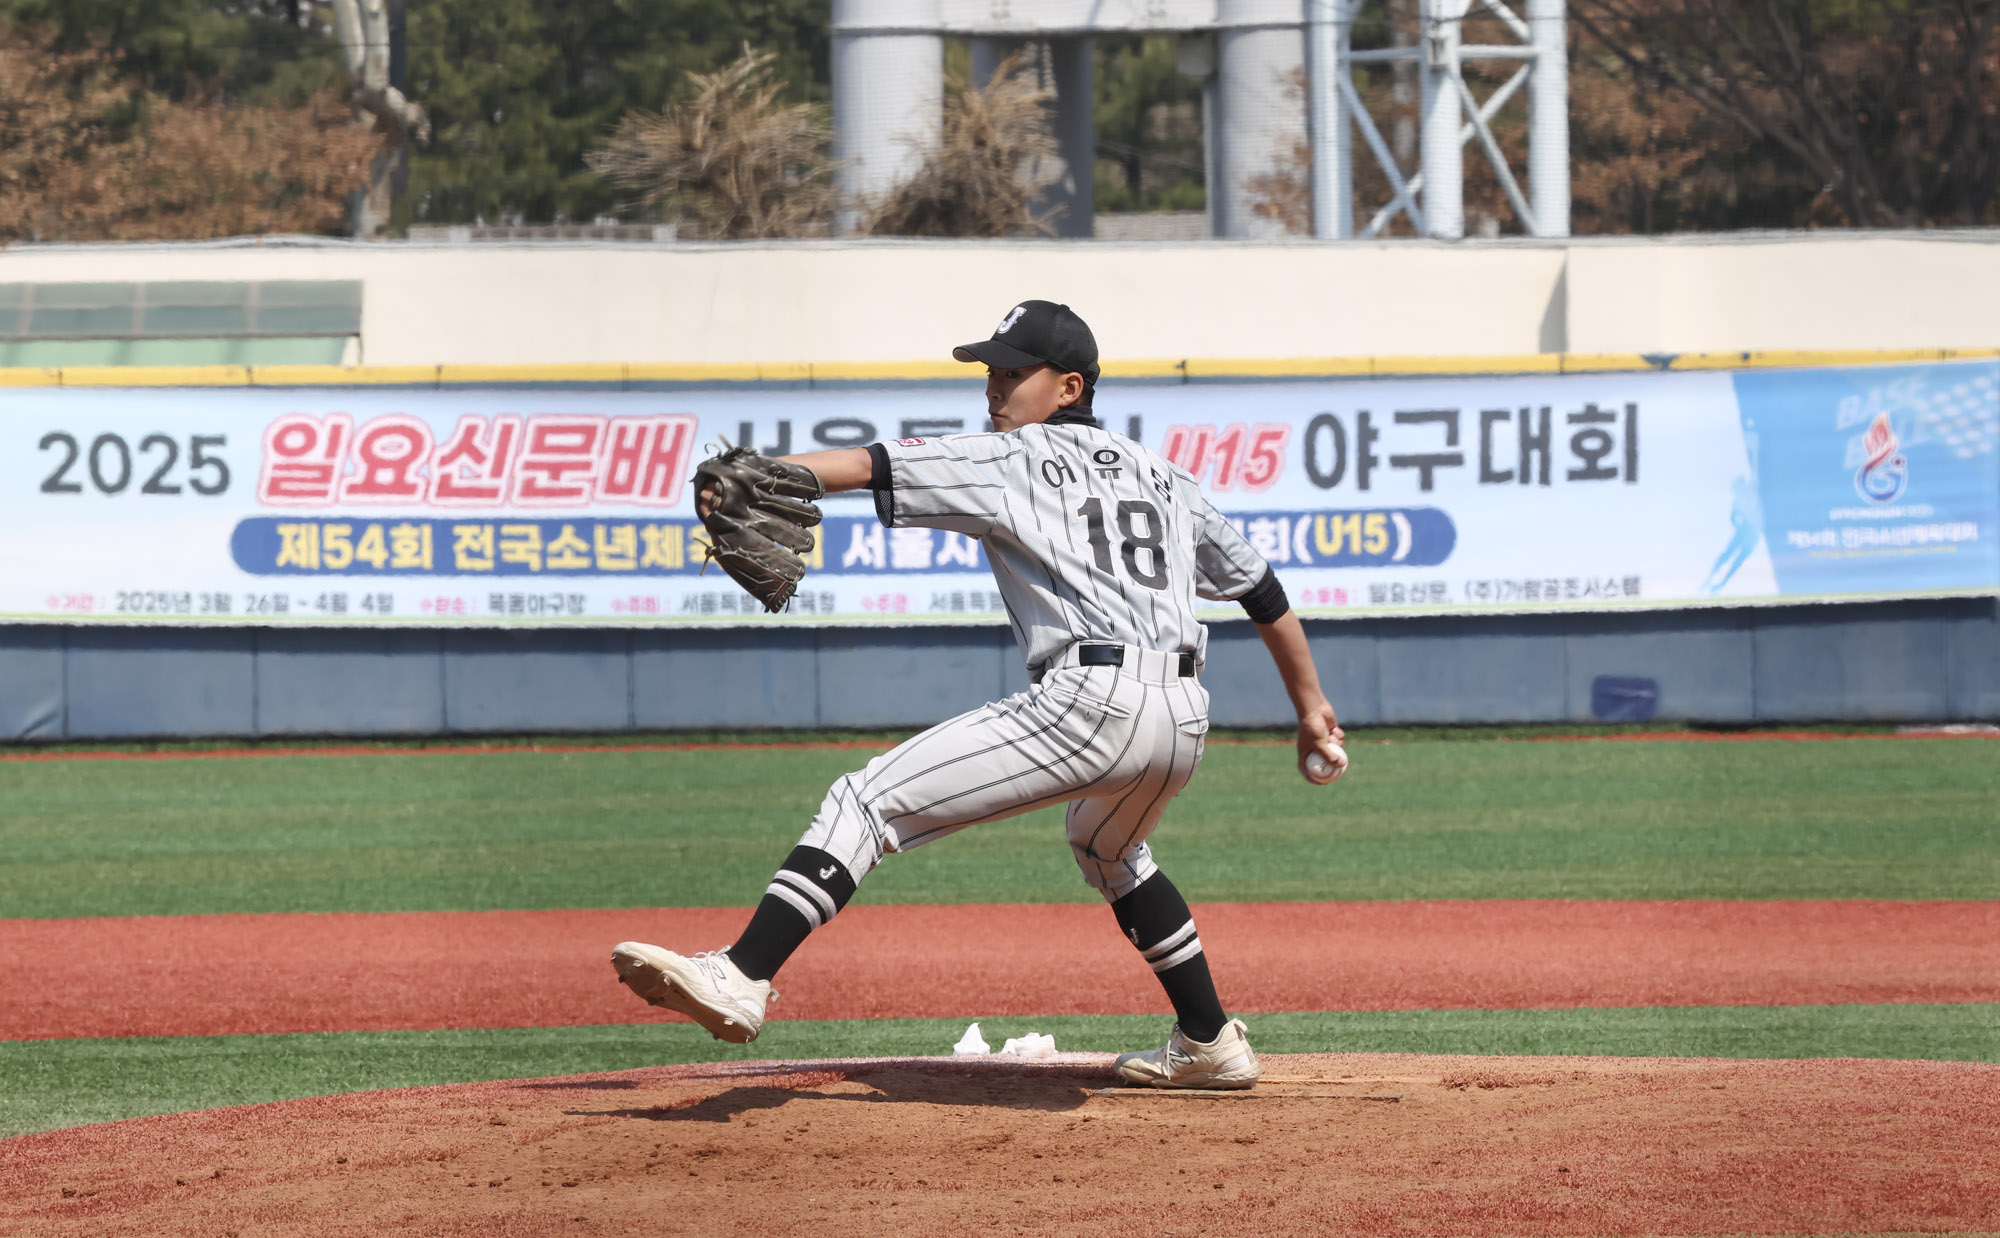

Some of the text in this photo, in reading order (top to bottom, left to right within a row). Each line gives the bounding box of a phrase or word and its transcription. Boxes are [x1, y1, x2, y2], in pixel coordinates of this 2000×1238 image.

[997, 306, 1027, 334] J
[38, 431, 230, 495] 2025
[258, 413, 698, 507] 일요신문배
[1158, 422, 1291, 493] U15
[1303, 402, 1640, 492] 야구대회
[276, 522, 434, 571] 제54회
[452, 522, 825, 572] 전국소년체
[1076, 496, 1169, 591] 18
